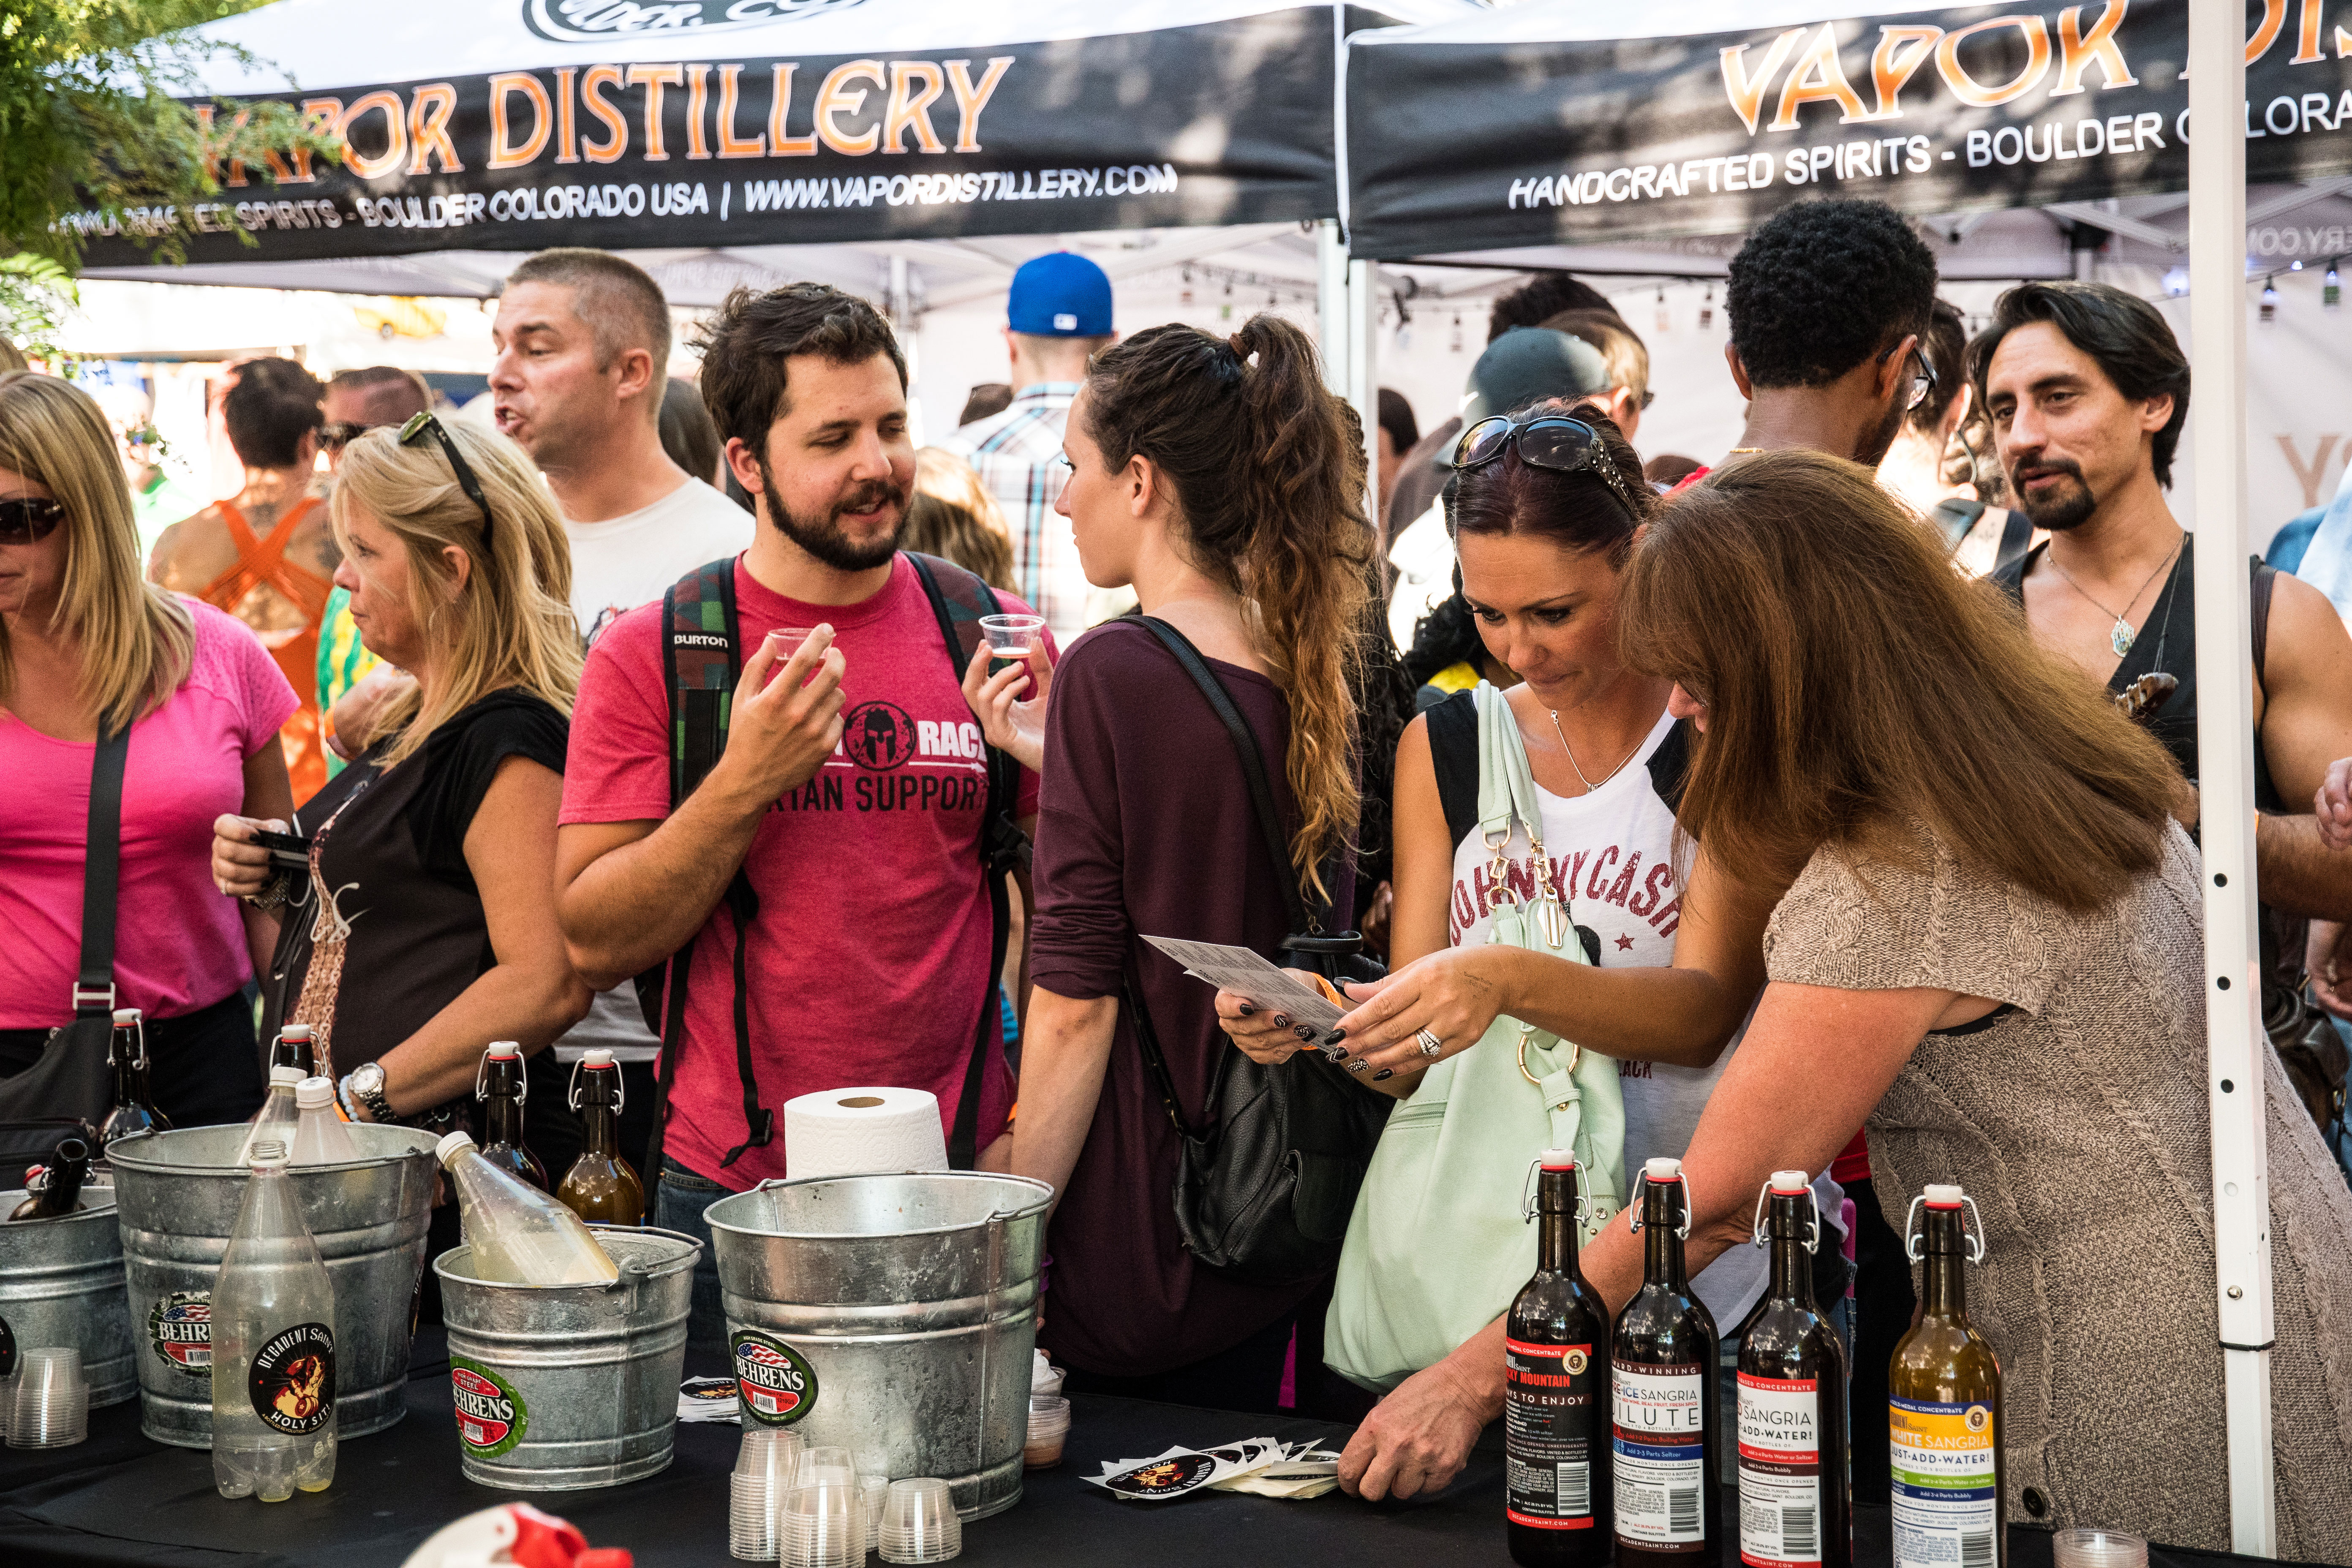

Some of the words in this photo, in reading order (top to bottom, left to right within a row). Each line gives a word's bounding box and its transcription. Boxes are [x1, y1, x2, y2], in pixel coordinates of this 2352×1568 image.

[1719, 0, 2139, 136] VAPOR
[487, 54, 1017, 171] DISTILLERY
[1509, 151, 1775, 210] HANDCRAFTED
[1784, 134, 1932, 186] SPIRITS
[1966, 112, 2166, 169] BOULDER
[2176, 90, 2352, 144] CLORA
[235, 198, 343, 231] SPIRITS
[356, 193, 487, 229] BOULDER
[490, 184, 645, 222] COLORADO
[651, 182, 709, 216] USA
[744, 163, 1178, 214] WWW.VAPORDISTILLERY.COM
[674, 634, 728, 648] BURTON
[1619, 1060, 1652, 1079] ACK
[158, 1322, 211, 1342] BEHR
[258, 1328, 307, 1368] DECADENT
[310, 1328, 333, 1354] SAINT
[763, 1340, 776, 1349] STEEL
[1507, 1342, 1522, 1352] LD-MEDAL
[736, 1354, 804, 1390] BEHRENS
[1516, 1364, 1530, 1372] SAINT
[1613, 1361, 1696, 1375] WARD-WINNING
[460, 1379, 479, 1390] STEEL
[467, 1376, 482, 1384] GRADE
[1521, 1372, 1570, 1387] MOUNTAIN
[1756, 1383, 1811, 1391] CONCENTRATE
[1507, 1388, 1517, 1399] AYS
[1522, 1394, 1535, 1403] TO
[1542, 1396, 1584, 1405] ENJOY
[1623, 1386, 1639, 1398] ICE
[1641, 1389, 1697, 1401] SANGRIA
[271, 1411, 307, 1429] HOLY
[313, 1404, 330, 1425] SIT!
[1738, 1402, 1742, 1416] D
[1744, 1406, 1811, 1425] SANGRIA
[264, 1416, 280, 1429] BOTTLED
[1908, 1424, 1927, 1433] SAINT
[1891, 1427, 1922, 1446] WHITE
[1925, 1435, 1989, 1449] SANGRIA
[1138, 1461, 1171, 1473] HOLY
[1183, 1462, 1211, 1487] DECADENT
[1114, 1473, 1134, 1481] SIT!
[1512, 1514, 1568, 1526] DECADENTSAINT.COM
[1621, 1536, 1679, 1549] DECADENTSAINT.COM
